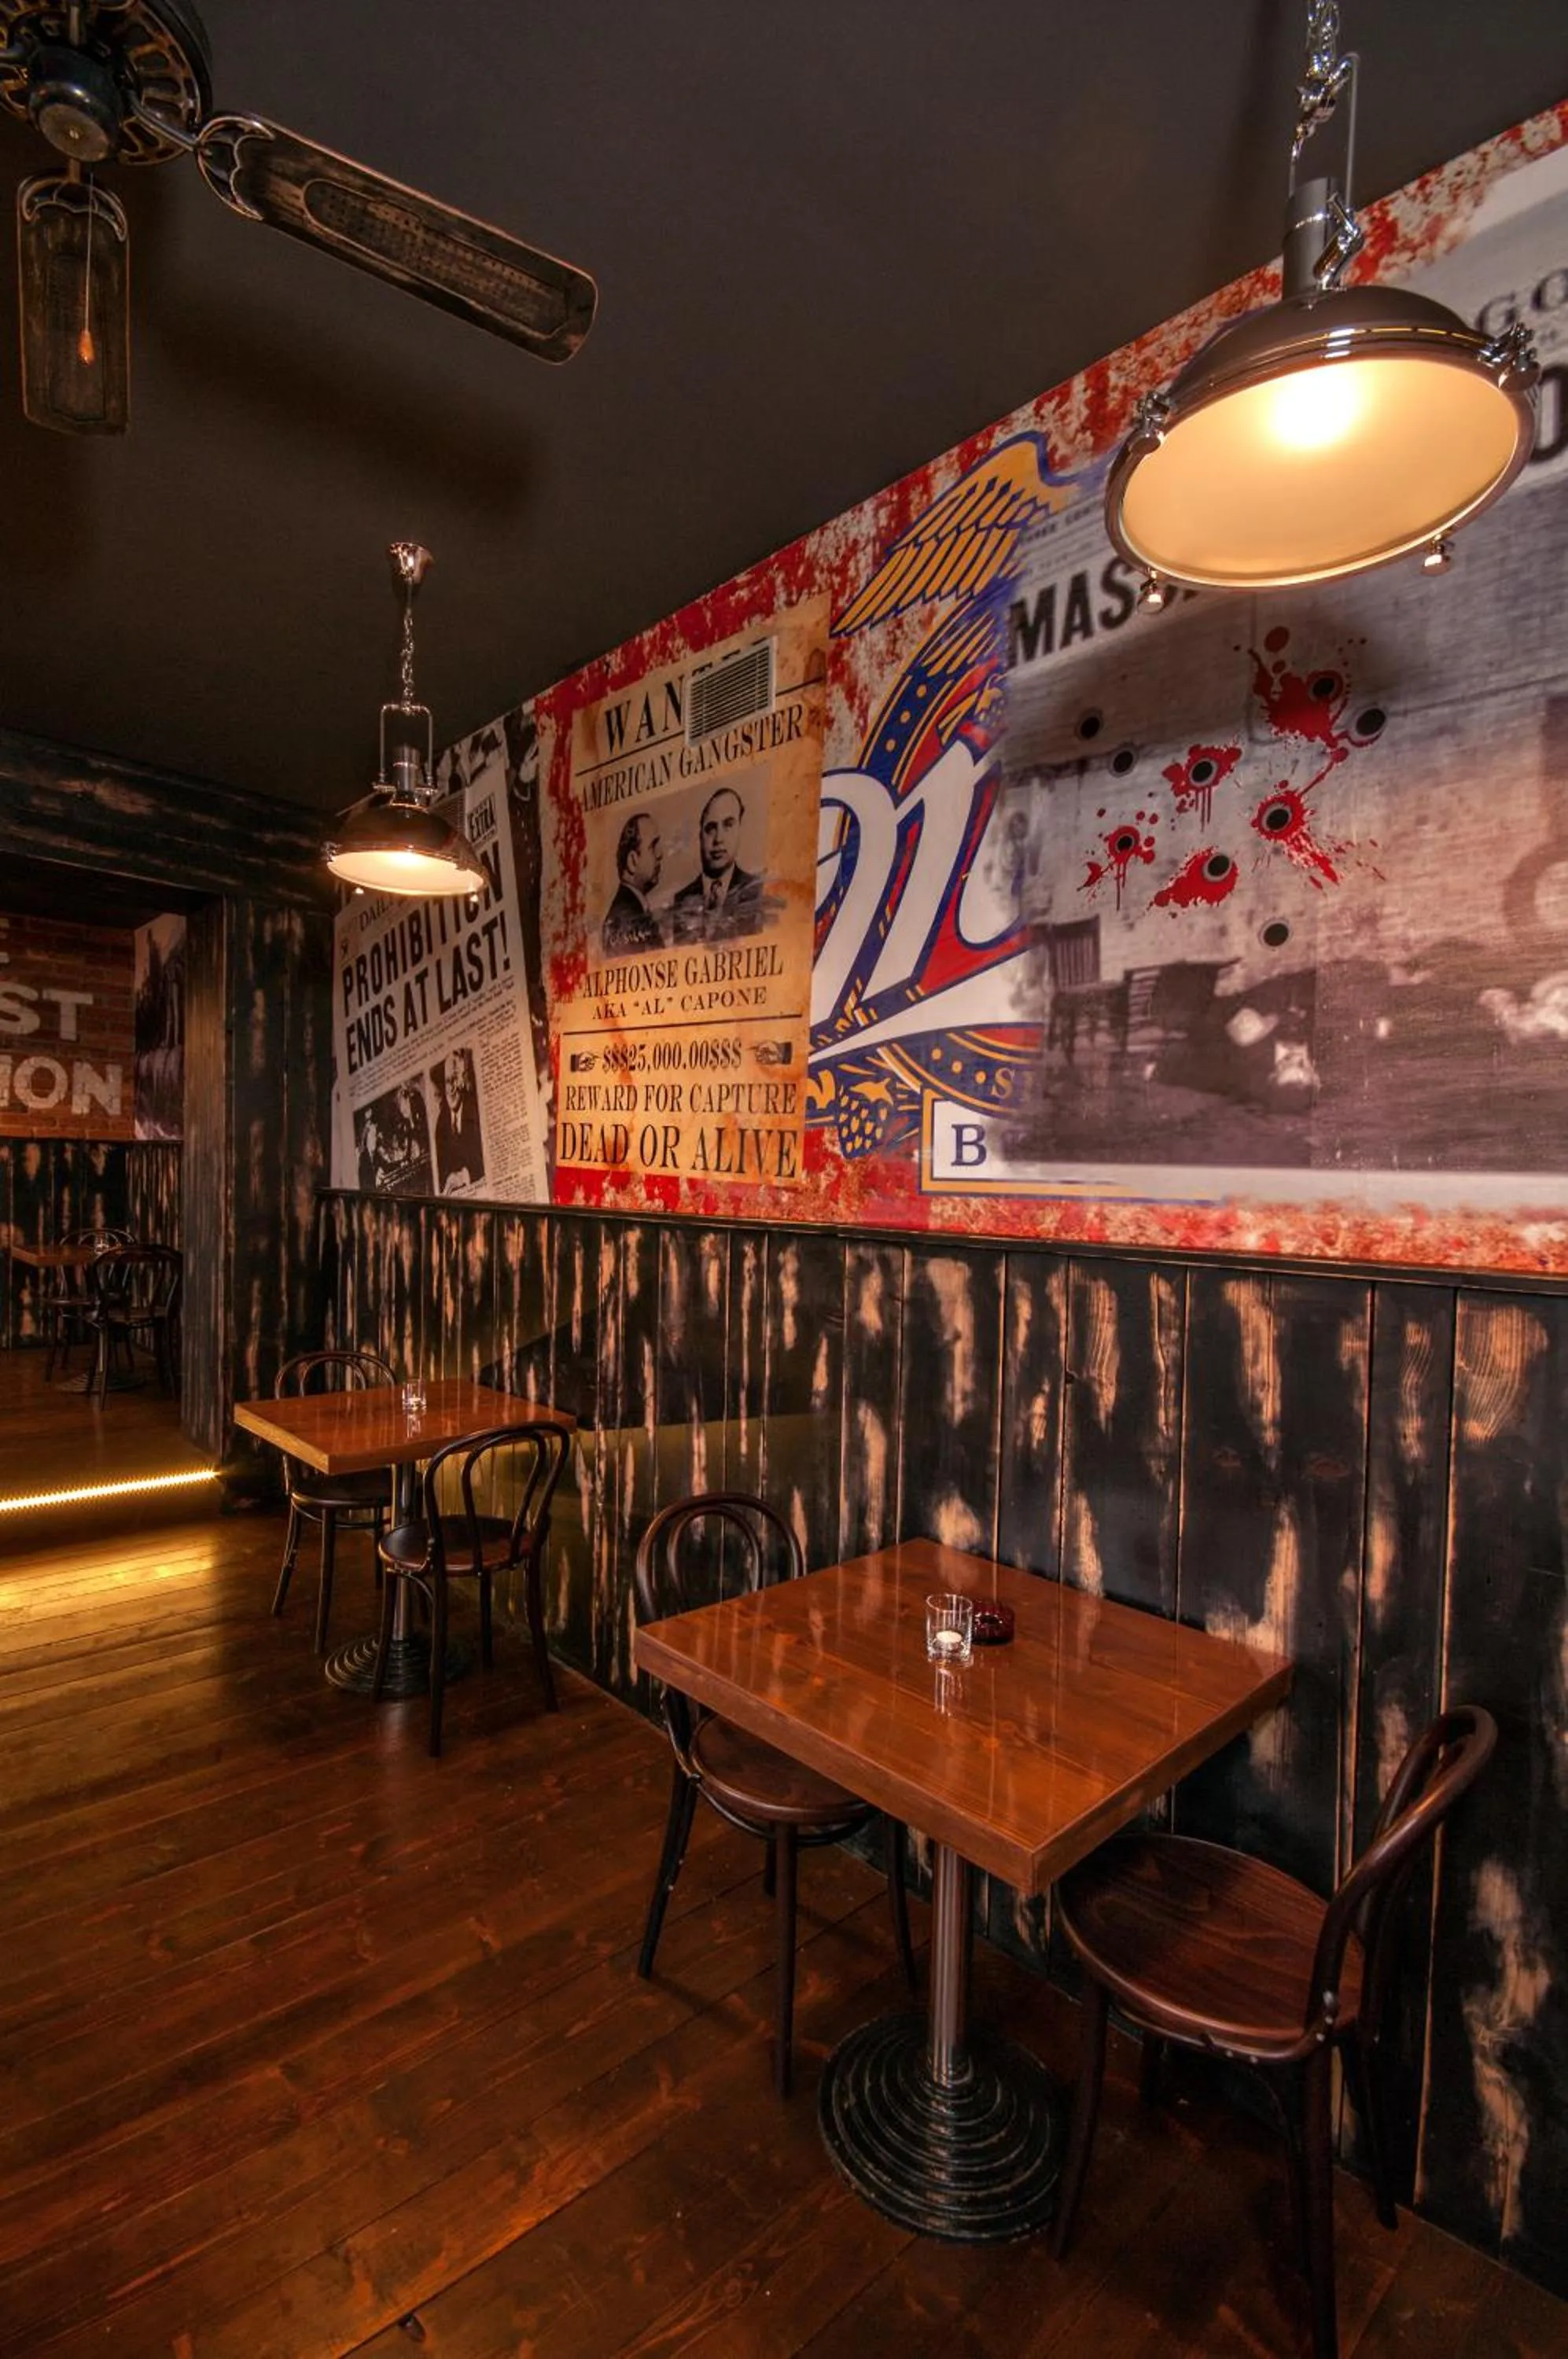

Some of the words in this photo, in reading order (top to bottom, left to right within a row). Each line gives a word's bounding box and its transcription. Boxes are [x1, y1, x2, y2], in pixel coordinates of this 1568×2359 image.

[580, 750, 674, 812] AMERICAN
[679, 703, 803, 779] GANGSTER
[347, 994, 399, 1076] ENDS
[404, 967, 429, 1040] AT
[436, 911, 510, 1015] LAST!
[583, 959, 679, 999] ALPHONSE
[684, 944, 784, 984] GABRIEL
[592, 1003, 627, 1020] AKA
[680, 986, 767, 1012] CAPONE
[565, 1084, 639, 1112] REWARD
[644, 1084, 683, 1113] FOR
[689, 1082, 797, 1114] CAPTURE
[560, 1121, 629, 1165] DEAD
[639, 1124, 681, 1169] OR
[690, 1126, 798, 1179] ALIVE
